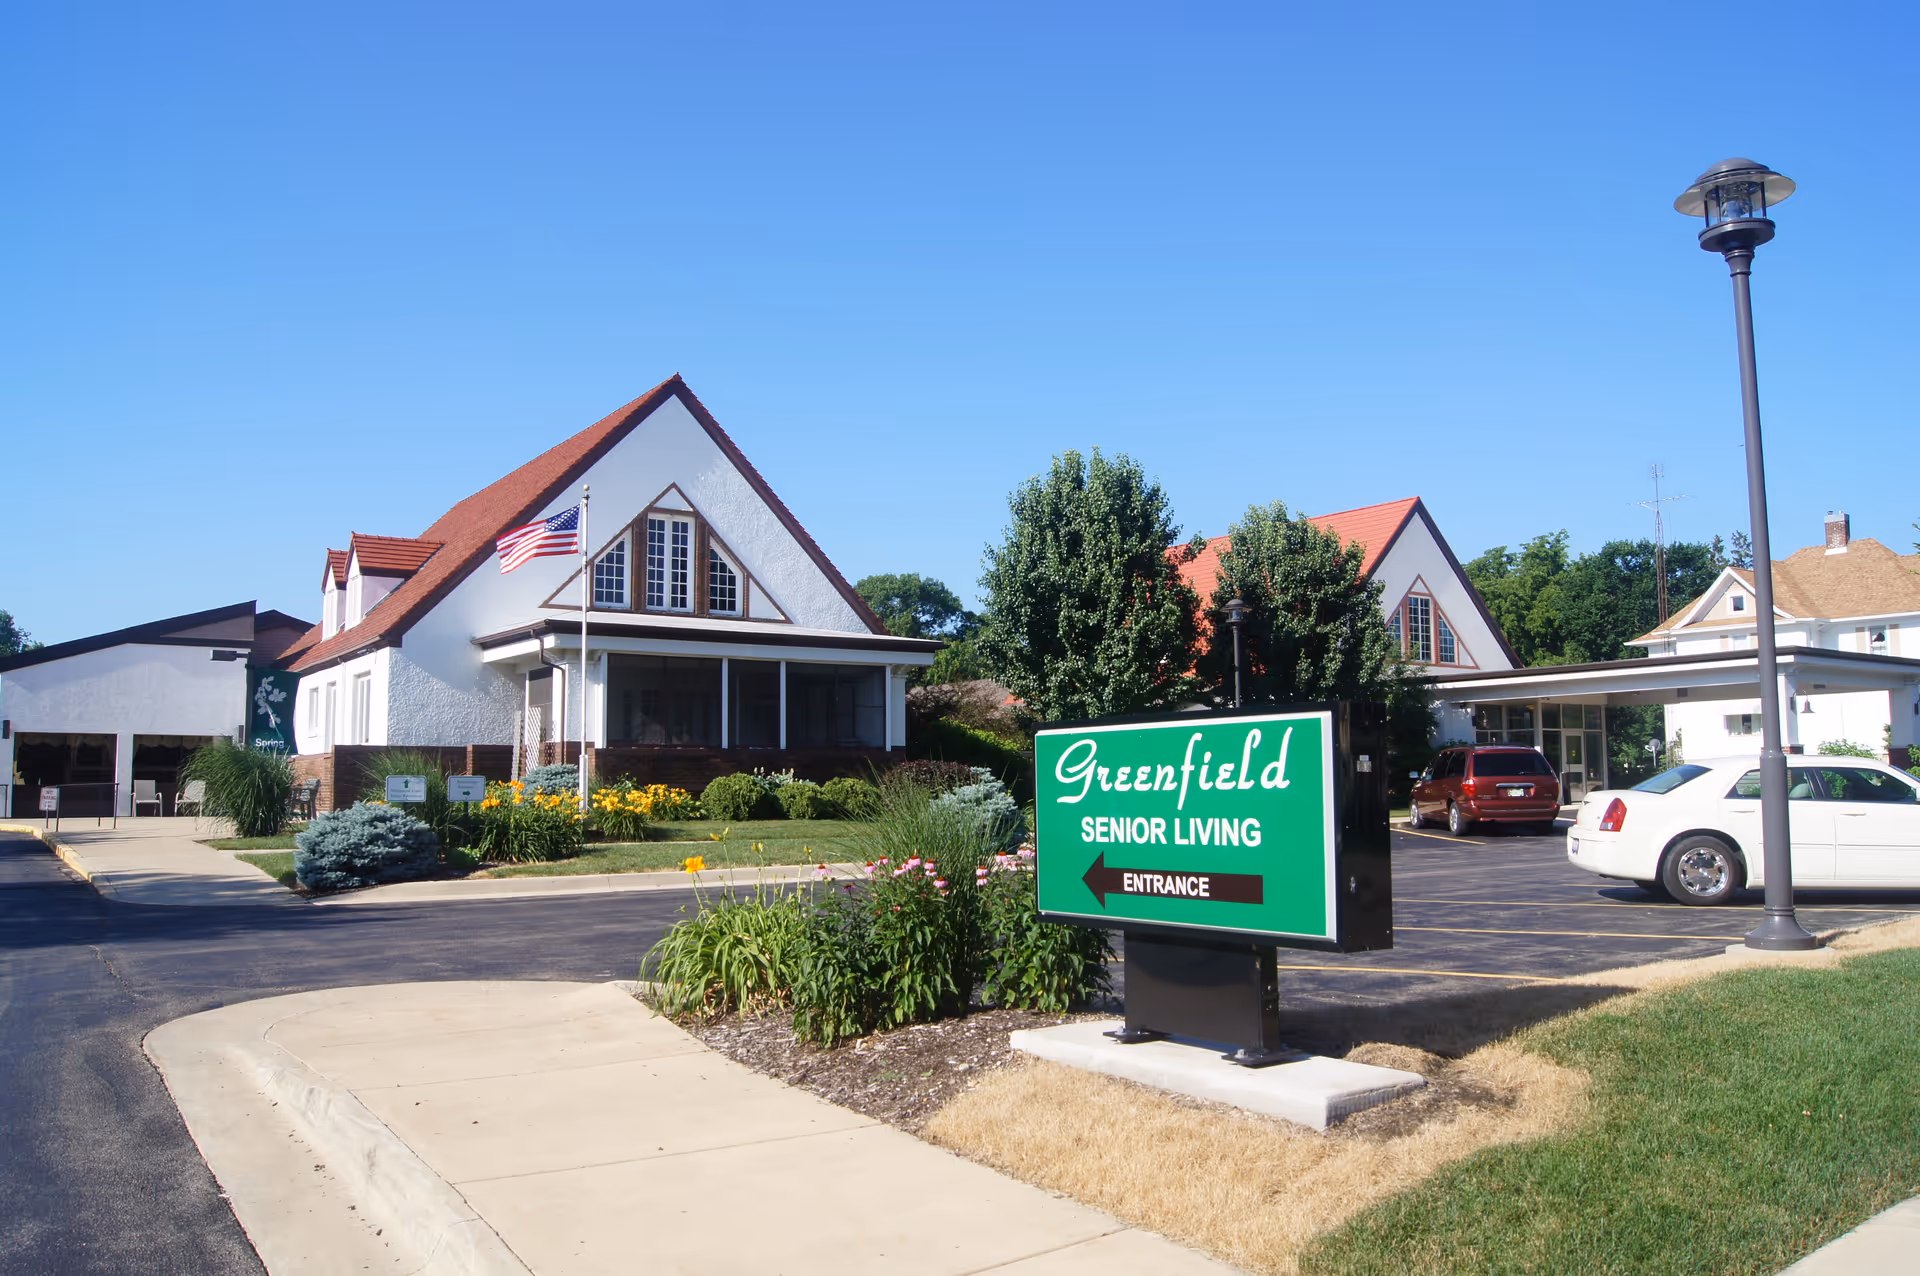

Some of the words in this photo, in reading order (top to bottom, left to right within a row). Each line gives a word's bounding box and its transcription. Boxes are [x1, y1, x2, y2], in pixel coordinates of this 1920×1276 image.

[255, 737, 285, 749] Spring
[1055, 726, 1293, 811] Greenfield
[1081, 816, 1168, 844] SENIOR
[1174, 817, 1262, 847] LIVING
[1123, 872, 1210, 897] ENTRANCE
